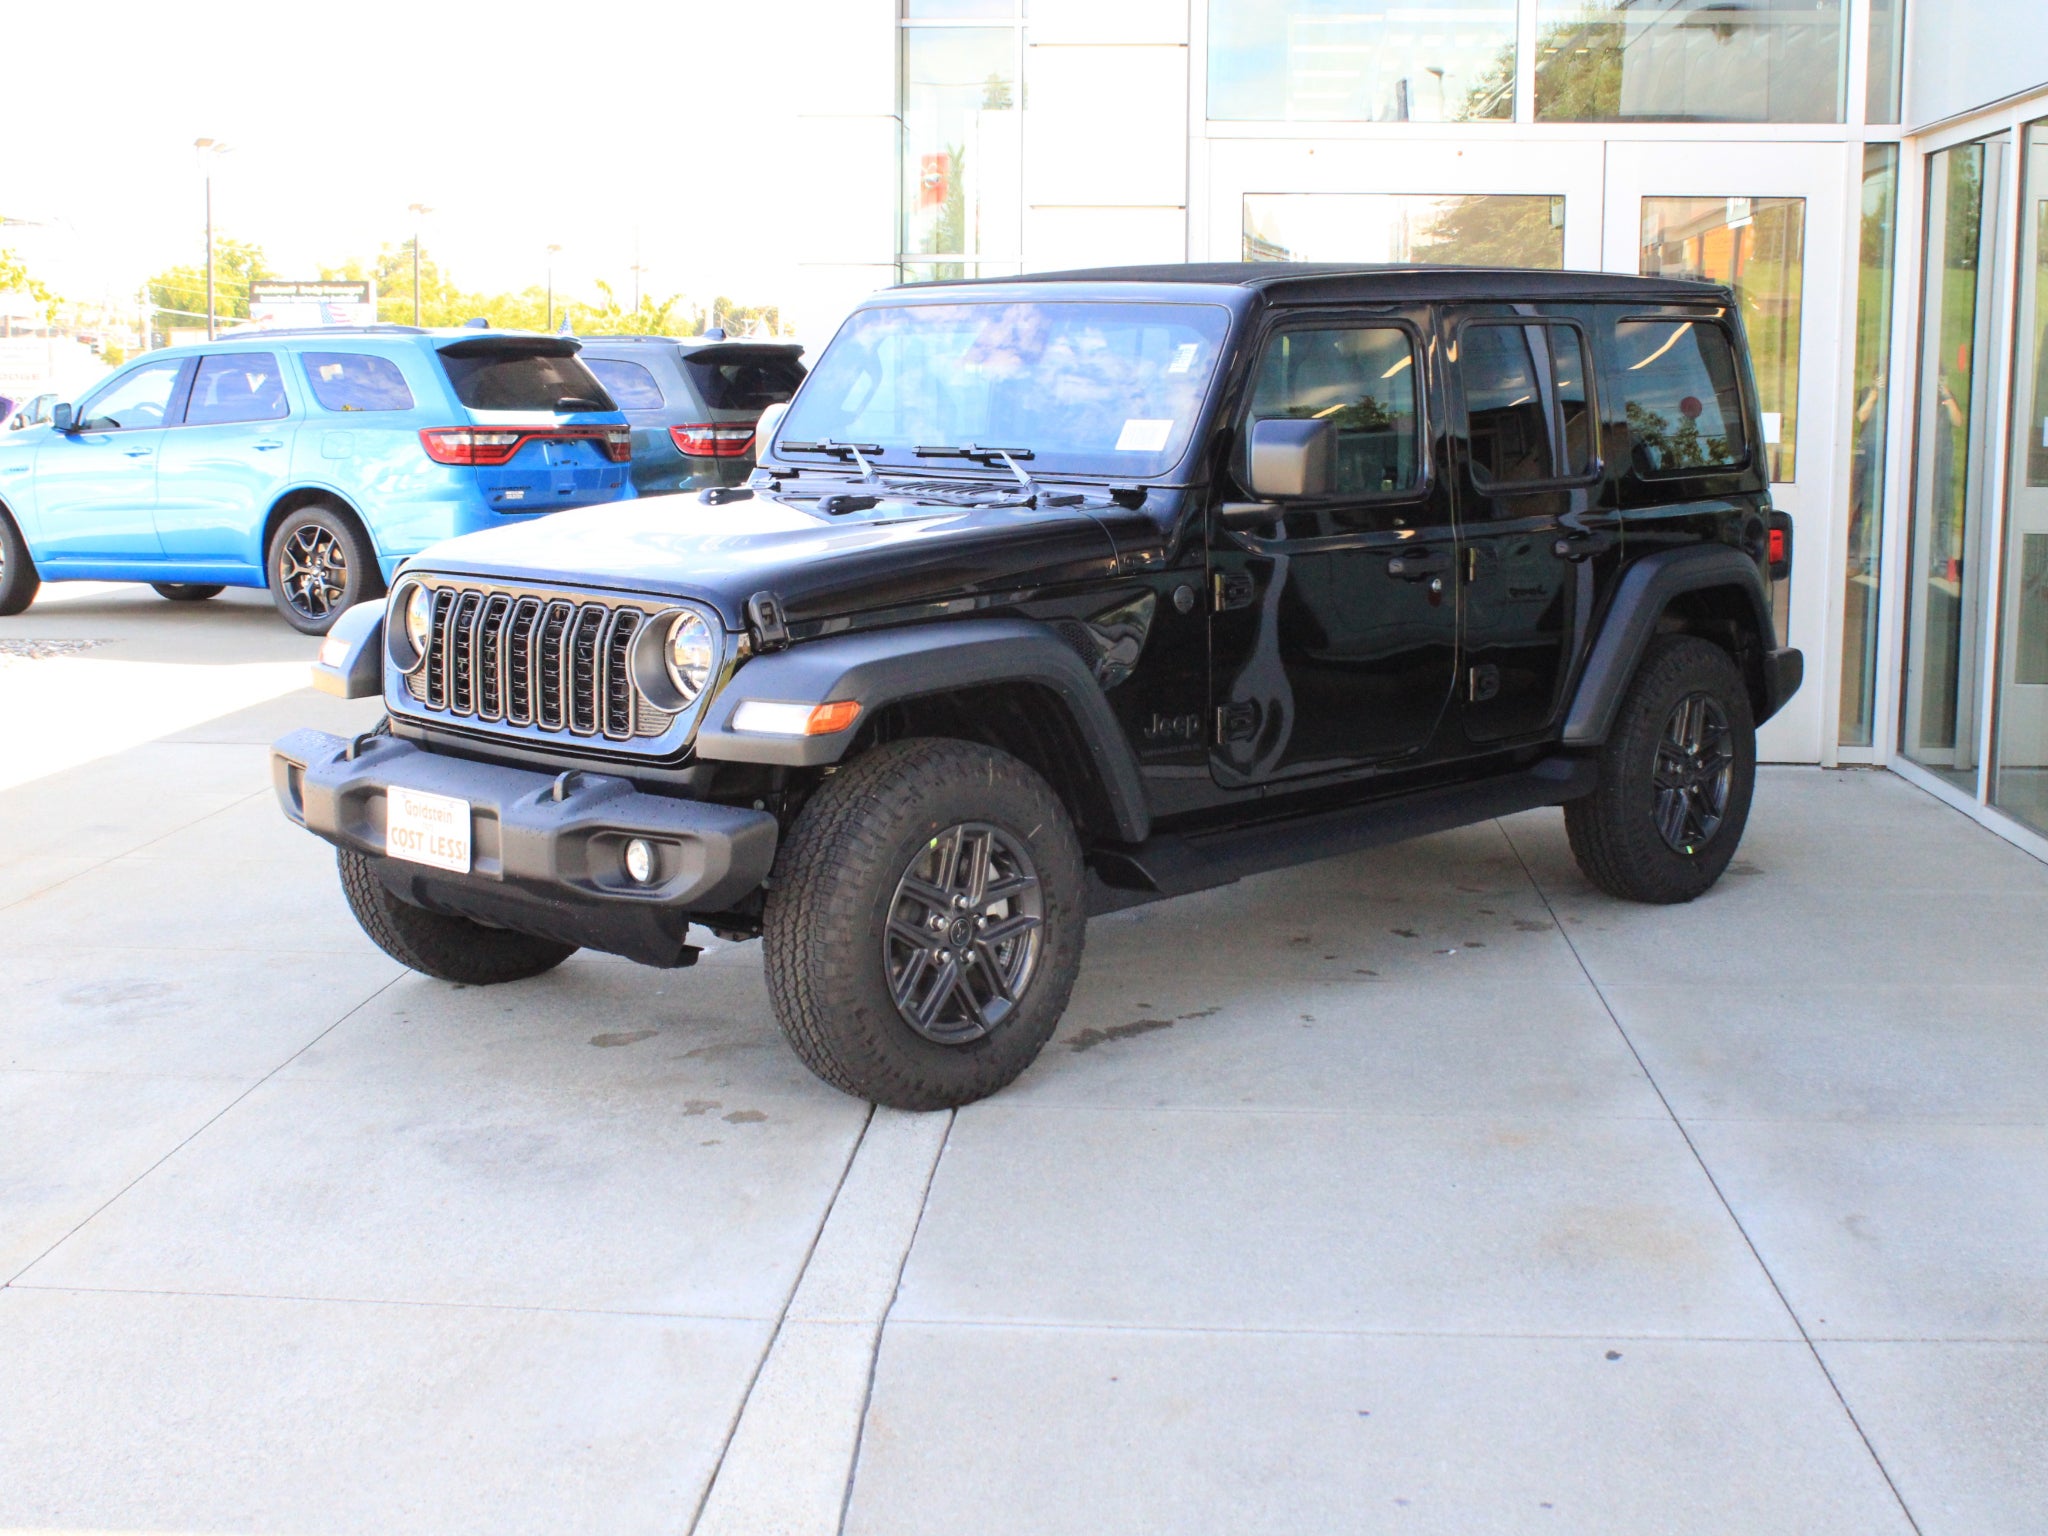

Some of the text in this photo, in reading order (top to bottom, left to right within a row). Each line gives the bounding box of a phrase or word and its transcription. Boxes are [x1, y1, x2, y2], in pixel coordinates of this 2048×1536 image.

[1143, 712, 1200, 739] Jeep
[404, 799, 453, 824] Goldstein
[391, 826, 467, 861] COST LESS!
